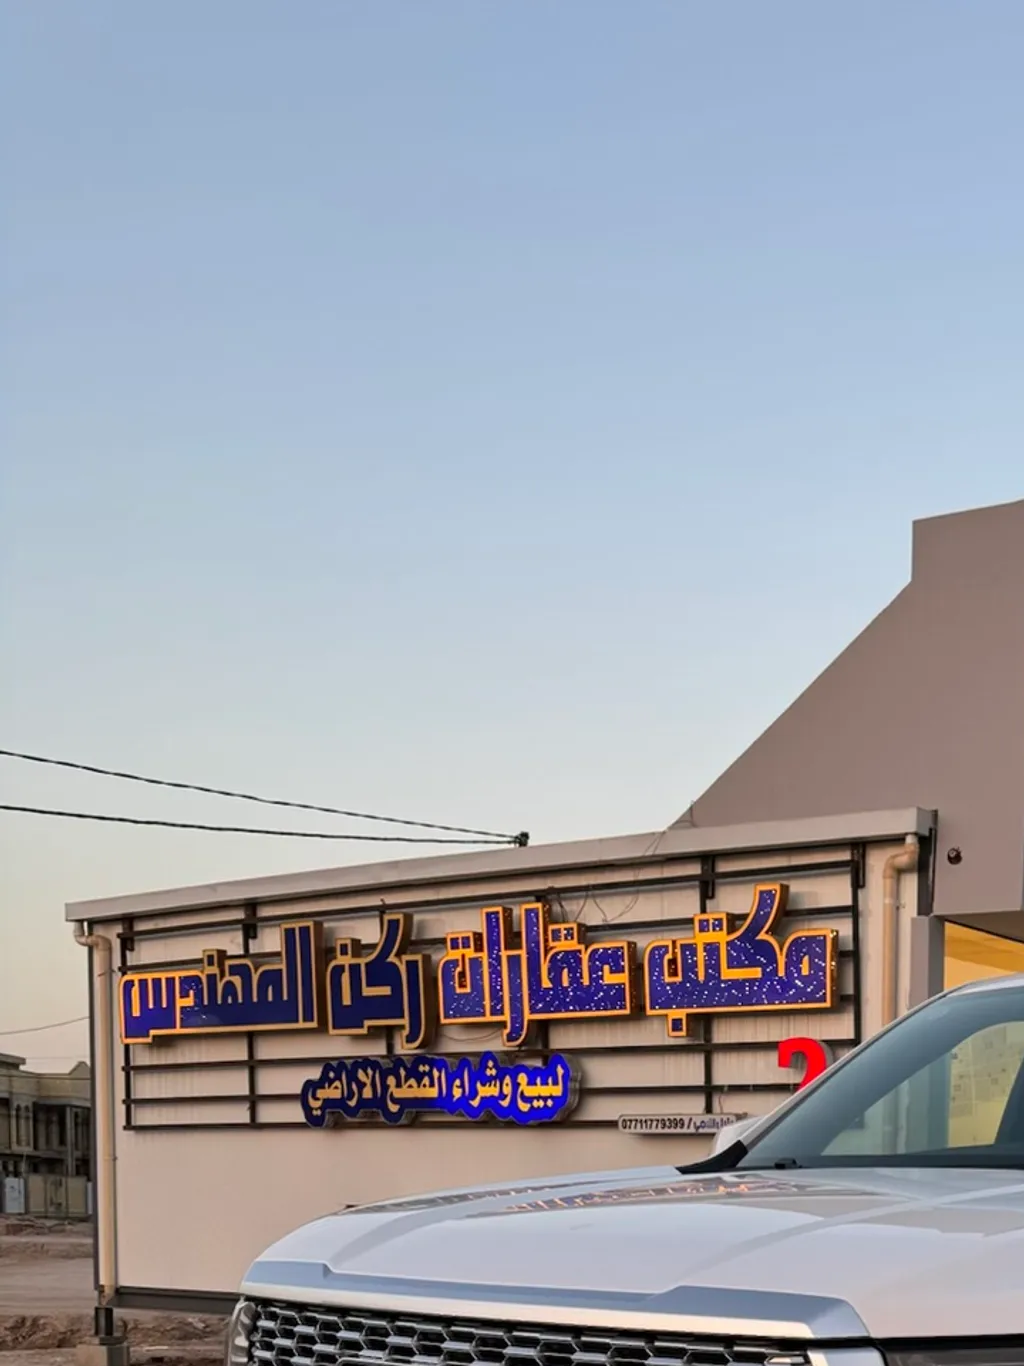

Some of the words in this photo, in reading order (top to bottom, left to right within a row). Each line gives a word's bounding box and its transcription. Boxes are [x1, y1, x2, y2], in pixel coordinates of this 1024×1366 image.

[119, 920, 320, 1044] المهندس
[326, 912, 423, 1050] ركن
[438, 902, 632, 1047] عقارات
[645, 883, 834, 1038] مكتب
[386, 1062, 447, 1113] القطع
[451, 1059, 512, 1109] وشراء
[515, 1063, 565, 1112] لبيع
[621, 1117, 685, 1131] 07711779399
